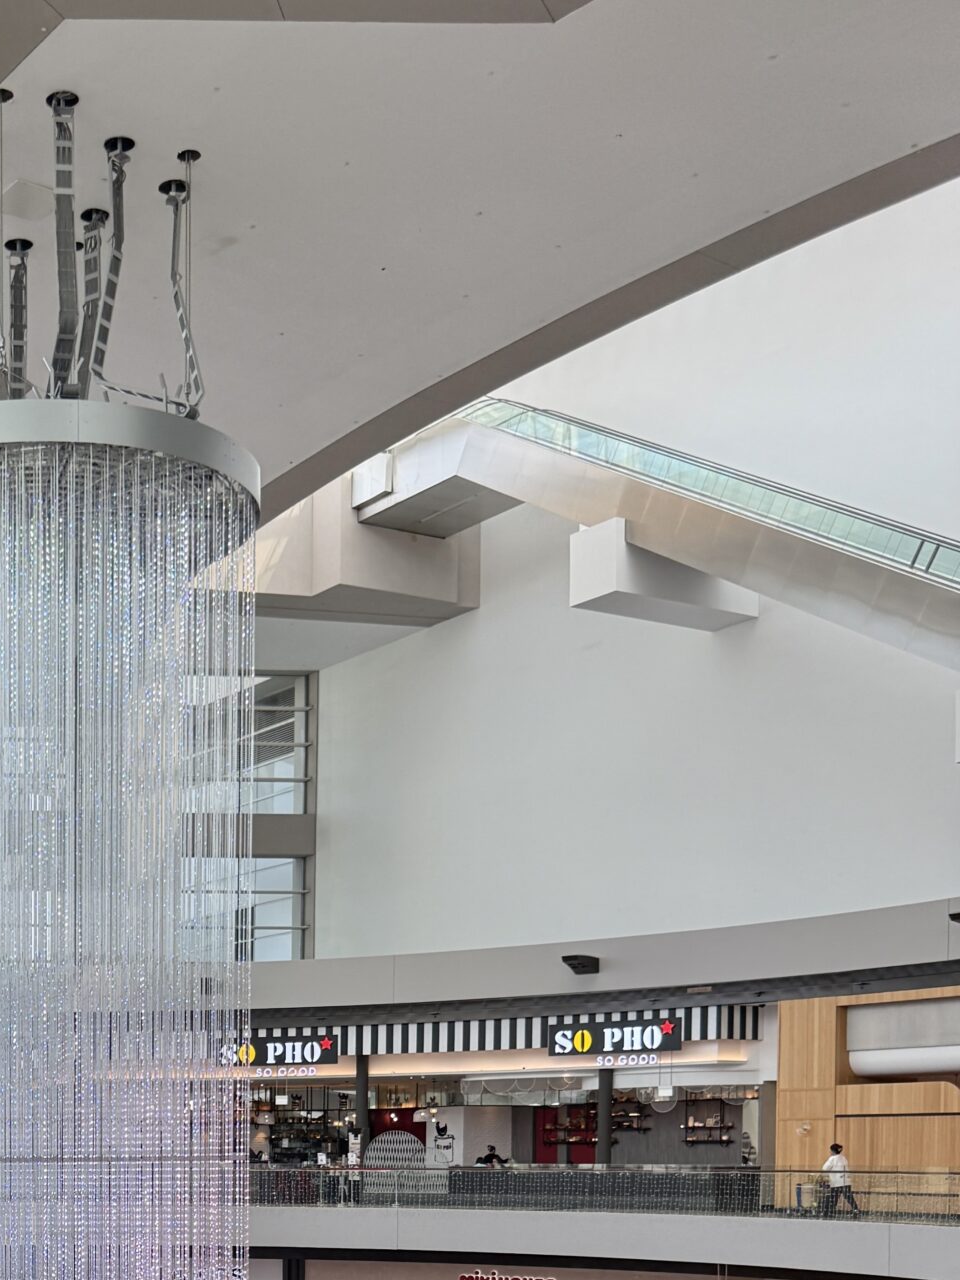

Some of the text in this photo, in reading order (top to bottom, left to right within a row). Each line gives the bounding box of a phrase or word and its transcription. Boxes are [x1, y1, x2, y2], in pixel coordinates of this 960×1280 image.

[554, 1025, 662, 1054] SO PHO
[266, 1042, 321, 1064] PHO
[597, 1054, 658, 1067] SO GOOD
